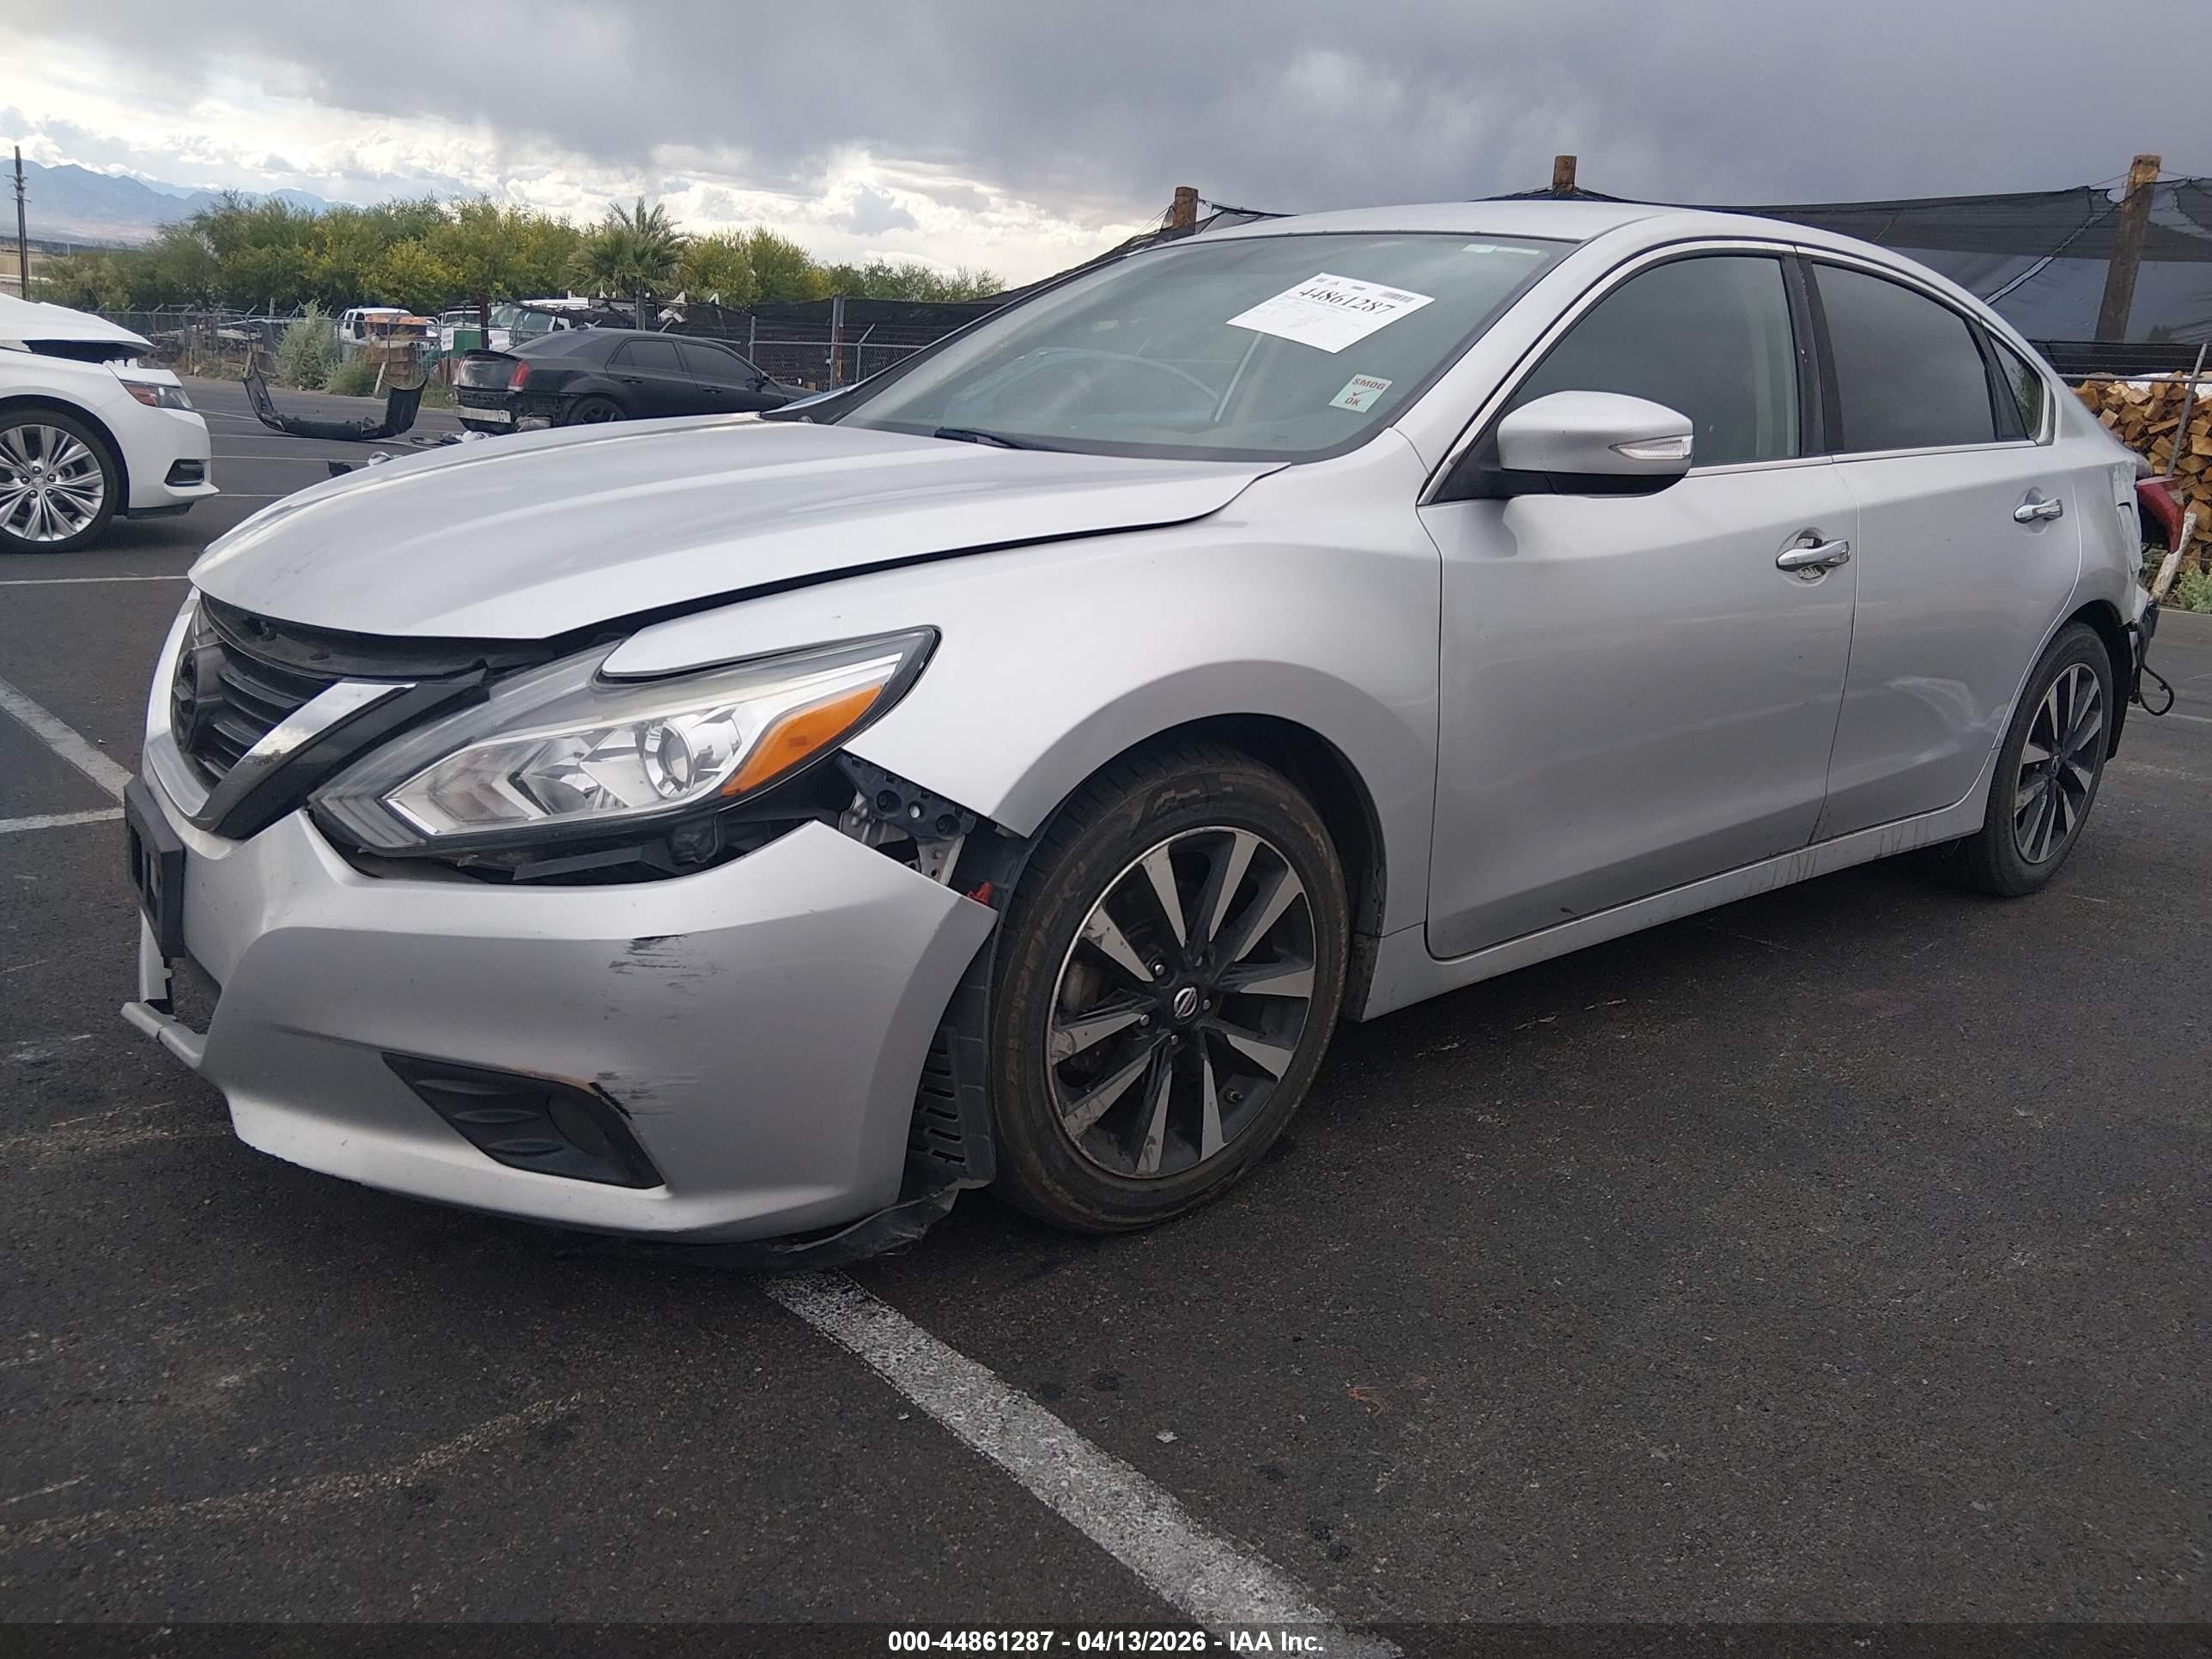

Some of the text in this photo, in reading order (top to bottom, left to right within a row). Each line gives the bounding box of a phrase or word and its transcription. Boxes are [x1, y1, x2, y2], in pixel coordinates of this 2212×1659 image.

[1298, 288, 1396, 315] 44861287
[1352, 378, 1386, 391] SMOG
[1345, 397, 1361, 406] OK
